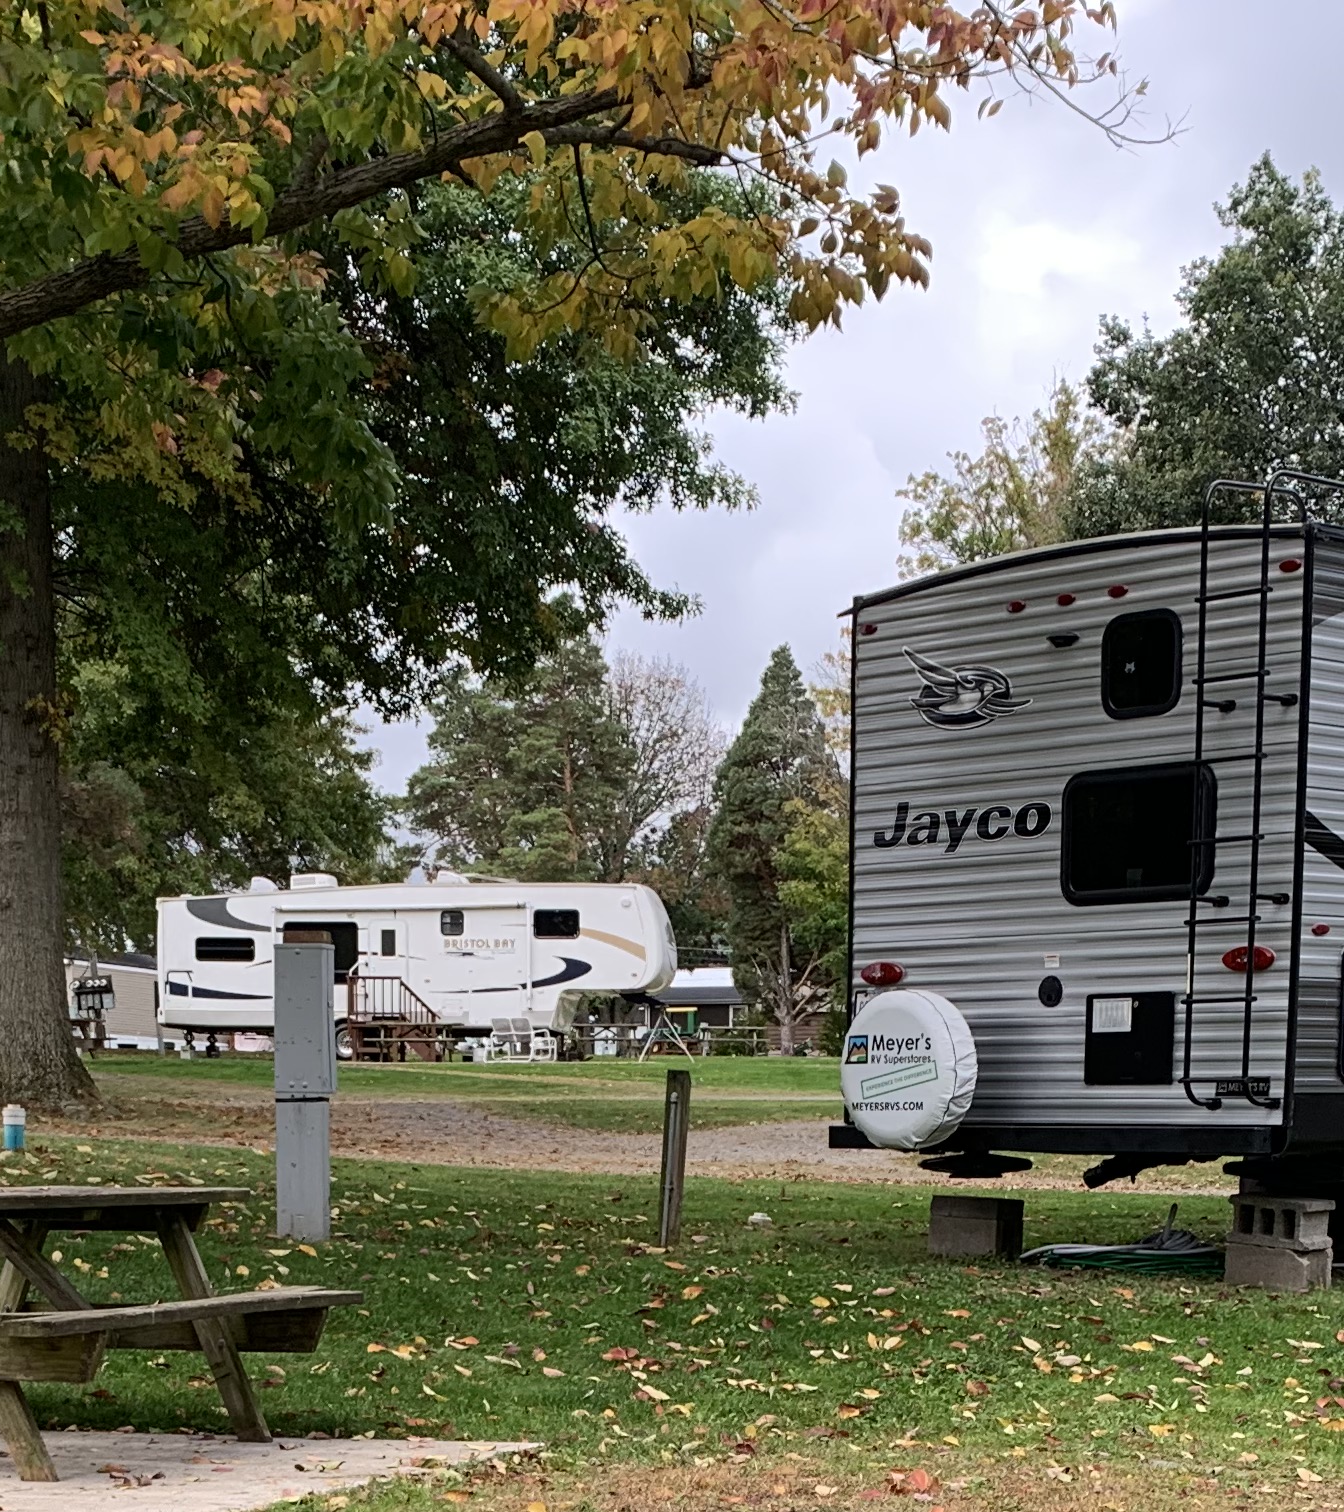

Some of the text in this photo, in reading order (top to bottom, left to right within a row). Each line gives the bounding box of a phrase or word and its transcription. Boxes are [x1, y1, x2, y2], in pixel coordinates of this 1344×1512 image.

[873, 800, 1053, 855] Jayco
[444, 938, 516, 950] BRISTOL BAY
[871, 1033, 932, 1055] Meyer's
[870, 1054, 931, 1066] RV Superstores
[851, 1101, 924, 1111] MEYERSRVS.COM
